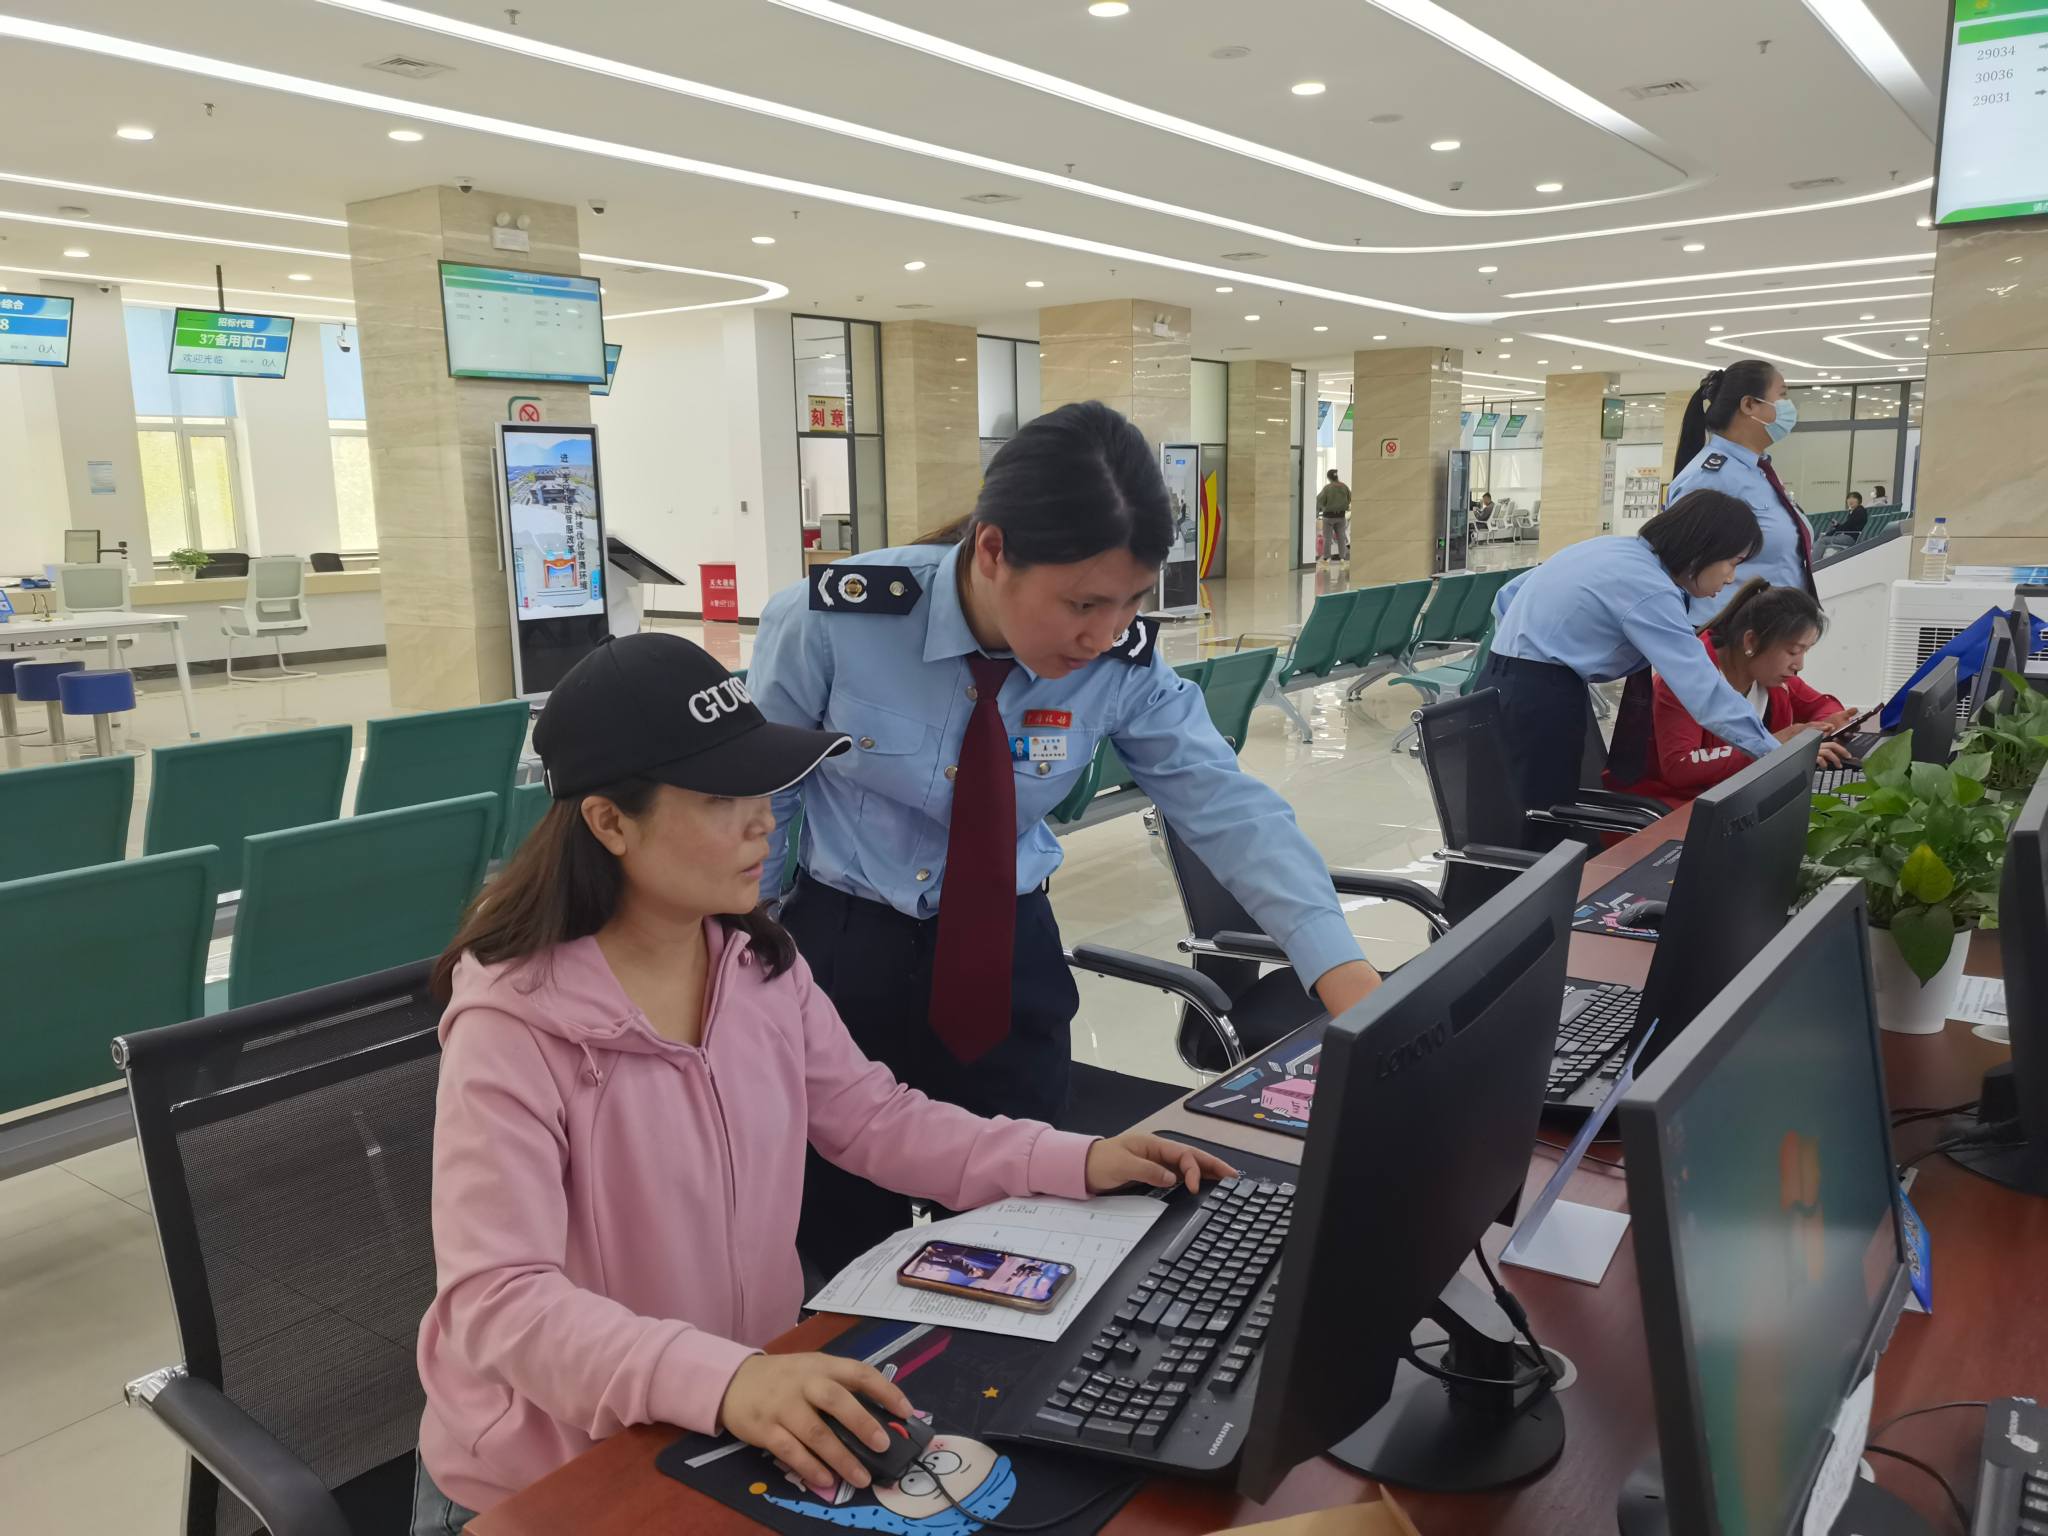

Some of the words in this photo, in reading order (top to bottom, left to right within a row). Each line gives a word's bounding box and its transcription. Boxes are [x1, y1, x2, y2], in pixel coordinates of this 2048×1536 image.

[1976, 45, 2016, 61] 29034
[1974, 68, 2014, 84] 30036
[1972, 91, 2011, 107] 29031
[217, 317, 255, 329] 招标代理
[199, 333, 267, 348] 37备用窗口
[38, 343, 57, 354] 0人
[183, 353, 223, 365] 欢迎光临
[261, 358, 277, 368] 0人
[811, 407, 844, 428] 刻章
[1209, 1422, 1235, 1456] lenovo
